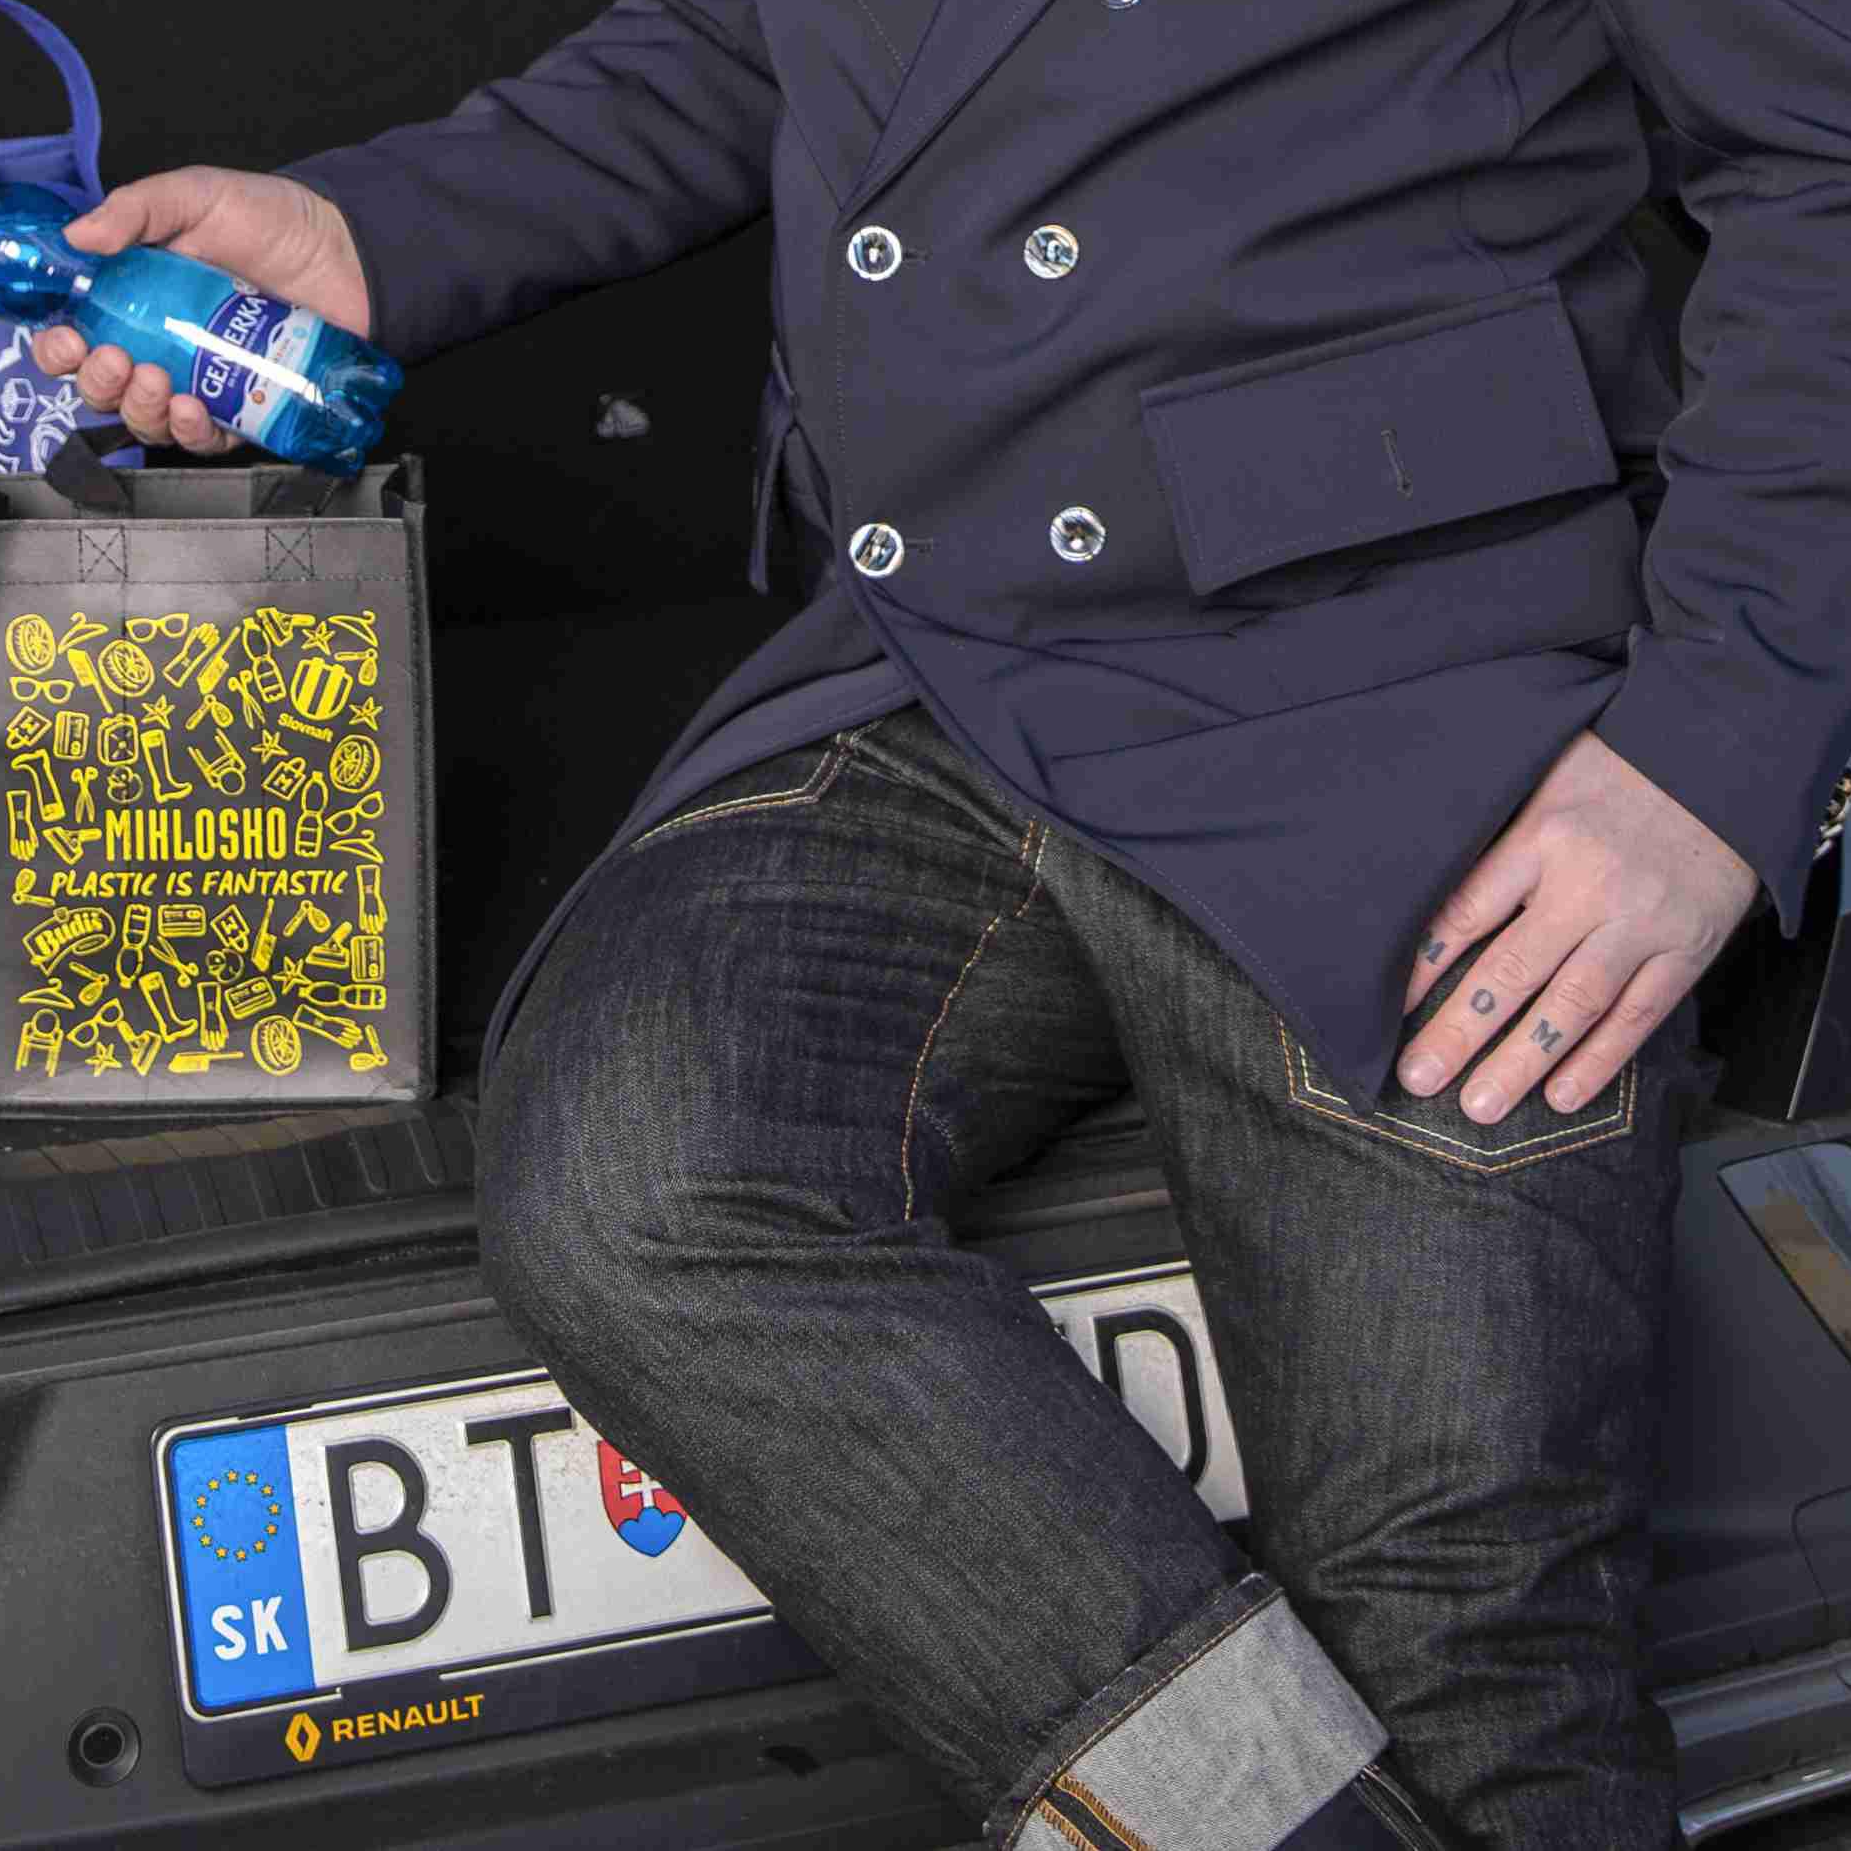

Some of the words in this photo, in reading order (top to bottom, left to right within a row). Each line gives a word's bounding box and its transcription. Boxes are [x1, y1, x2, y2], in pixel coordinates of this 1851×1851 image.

[278, 712, 333, 743] Slovnaft
[105, 807, 286, 861] MIHLOSHO
[51, 870, 154, 897] PLASTIC
[166, 871, 194, 896] IS
[203, 868, 348, 896] FANTASTIC
[323, 1404, 574, 1654] BT
[1054, 1304, 1212, 1489] D
[211, 1596, 288, 1661] SK
[331, 1693, 486, 1745] RENAULT
